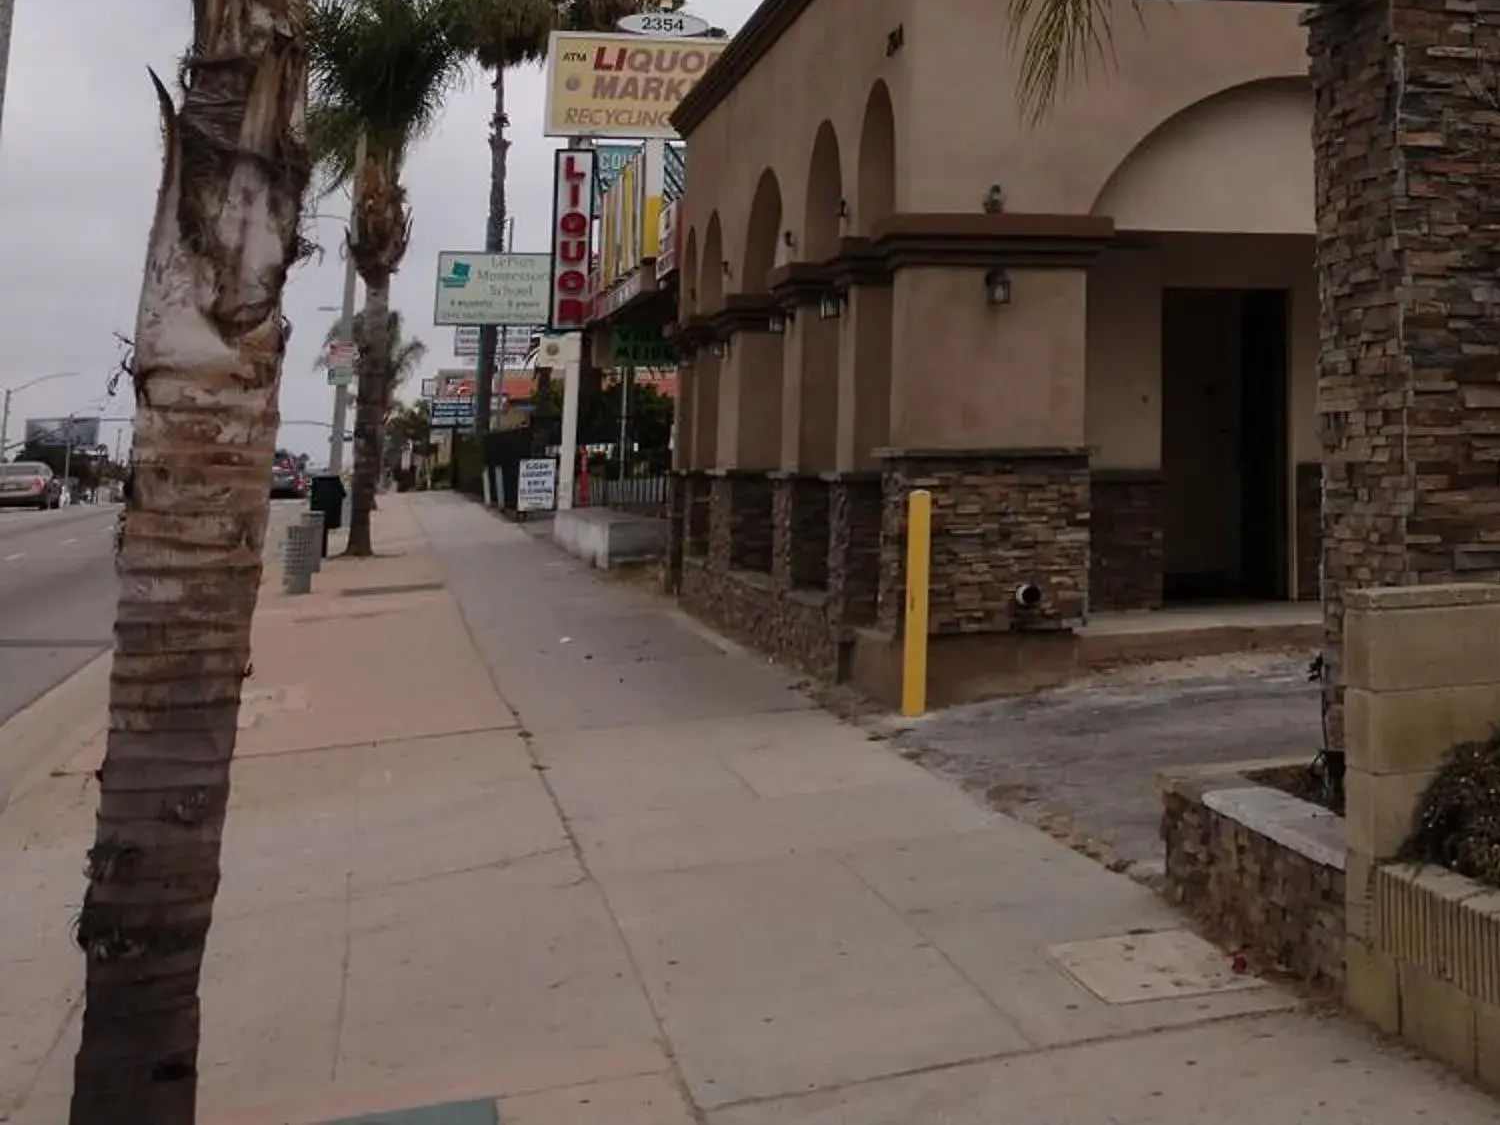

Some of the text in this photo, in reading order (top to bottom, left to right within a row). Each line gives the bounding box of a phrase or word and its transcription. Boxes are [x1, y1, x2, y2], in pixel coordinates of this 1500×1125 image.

[641, 17, 684, 32] 2354
[563, 52, 587, 63] ATM
[592, 76, 697, 101] MARK
[558, 155, 587, 324] LIQUOR
